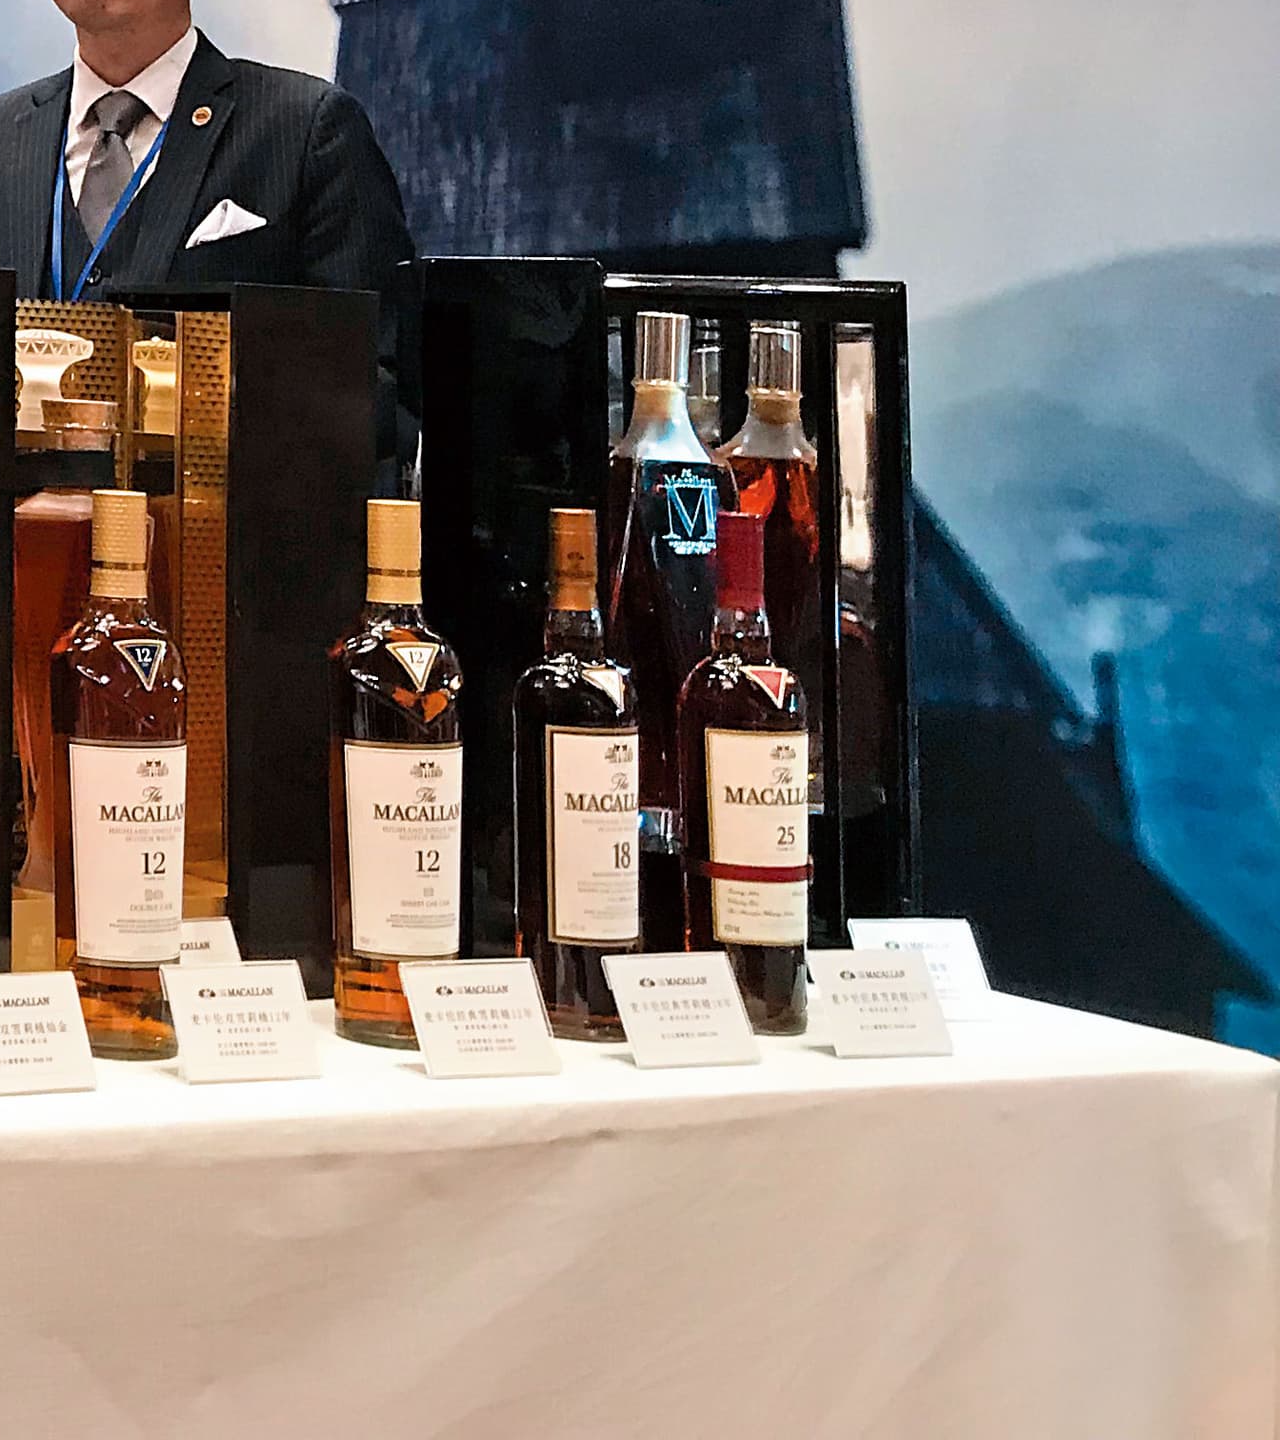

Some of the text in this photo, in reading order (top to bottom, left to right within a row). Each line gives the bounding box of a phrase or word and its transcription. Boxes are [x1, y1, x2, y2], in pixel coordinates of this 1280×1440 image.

[134, 648, 152, 662] 12
[610, 772, 629, 792] The
[771, 767, 793, 785] The
[142, 786, 163, 803] The
[414, 786, 437, 804] The
[777, 825, 796, 846] 25
[140, 851, 166, 876] 12
[415, 849, 441, 873] 12
[612, 841, 631, 869] 18
[228, 987, 273, 997] MACALLAN
[464, 985, 509, 995] MACALLAN
[2, 997, 50, 1008] MACALLAN
